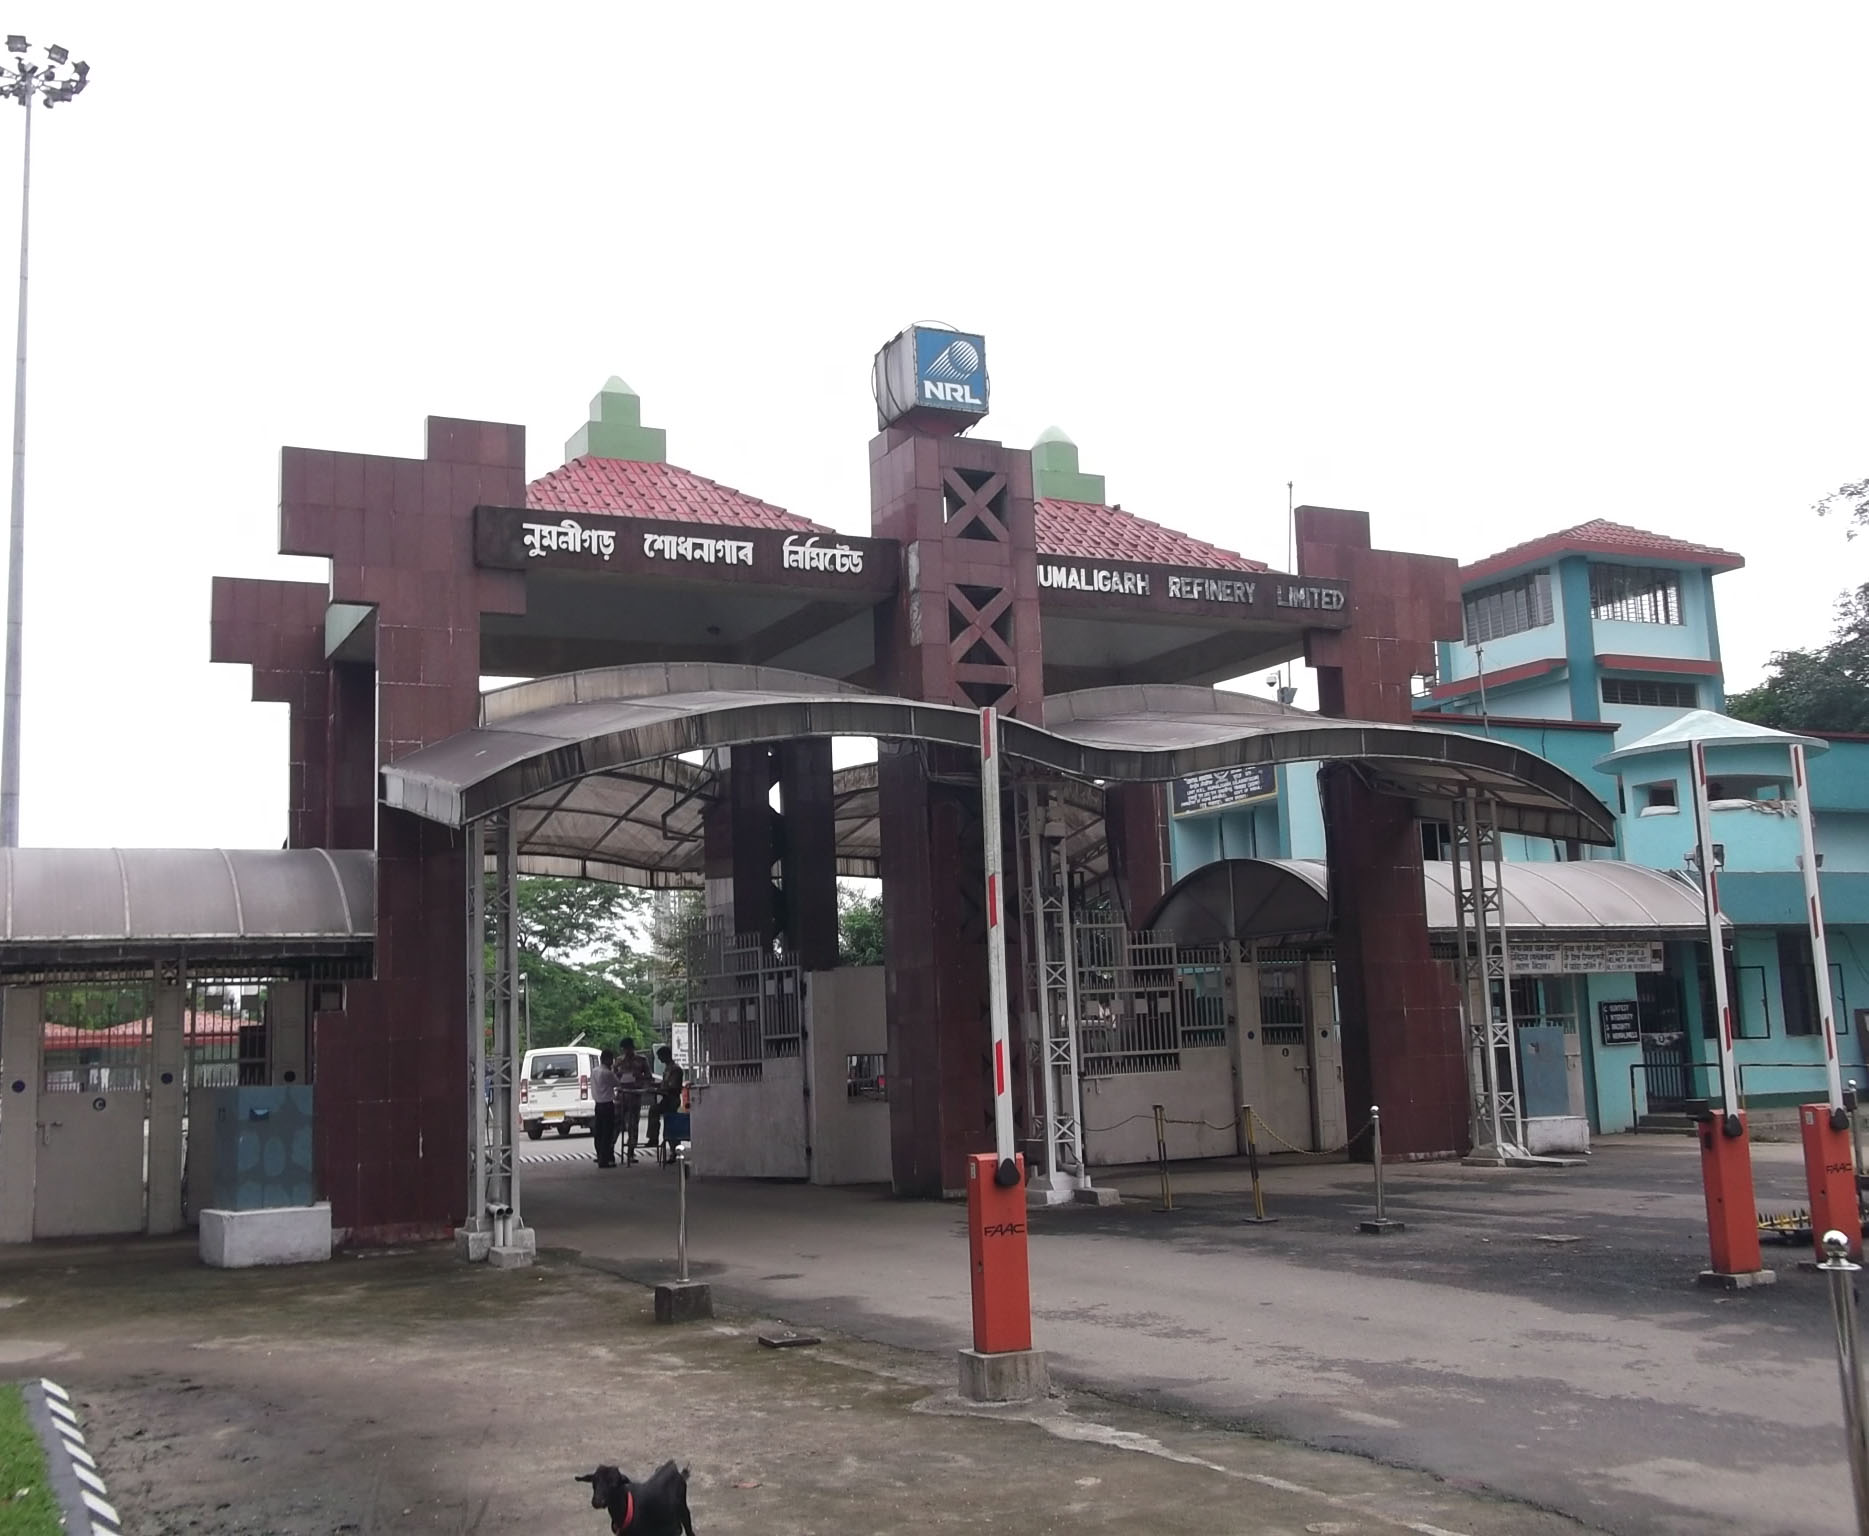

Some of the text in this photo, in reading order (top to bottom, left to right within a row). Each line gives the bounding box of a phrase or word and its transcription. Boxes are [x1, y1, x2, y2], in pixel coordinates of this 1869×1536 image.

[923, 380, 982, 405] NRL
[1036, 565, 1345, 611] UMALIGARH REFINERY LIMITED
[984, 1223, 1025, 1237] FAAC
